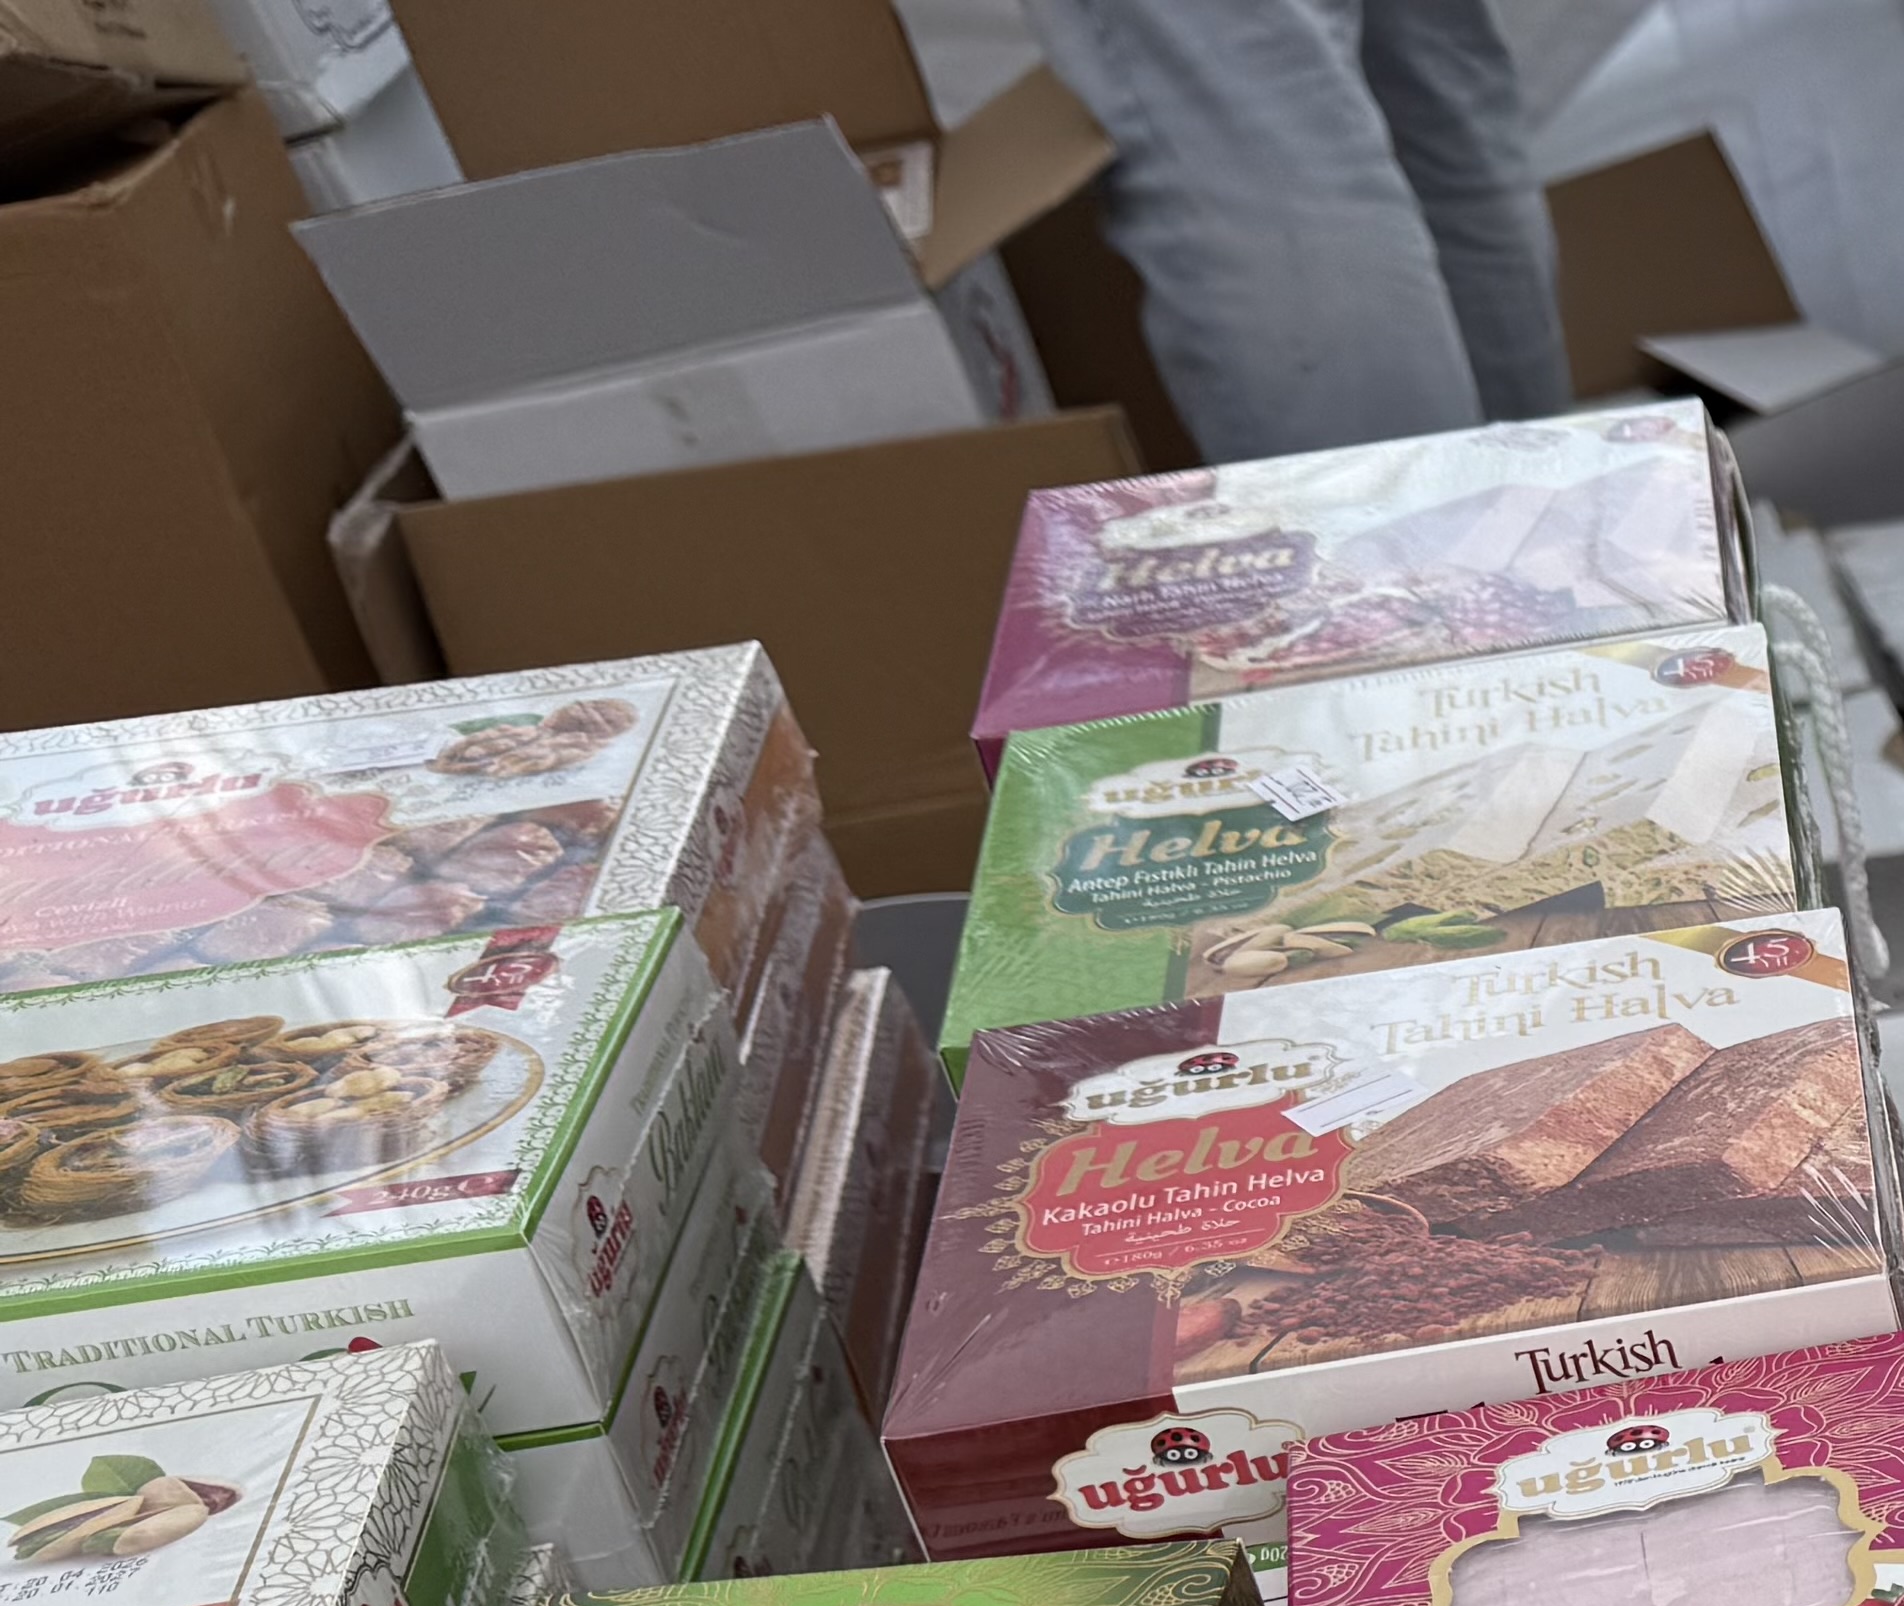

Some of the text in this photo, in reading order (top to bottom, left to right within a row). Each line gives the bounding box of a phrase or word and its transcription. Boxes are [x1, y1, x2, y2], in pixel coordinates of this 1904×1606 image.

[1428, 666, 1603, 723] Turkish
[1347, 696, 1670, 761] Tahini Halva
[1069, 873, 1130, 896] Antep
[1202, 857, 1257, 878] Tahin
[1261, 850, 1319, 870] Helva
[1082, 819, 1309, 871] Helva
[1091, 867, 1292, 905] Tahini Halva Pistachio
[1451, 953, 1663, 1003] Turkish
[1370, 984, 1741, 1056] Tahini Halva
[1086, 1059, 1313, 1109] uğurlu
[1057, 1124, 1321, 1195] Helva
[1042, 1165, 1326, 1226] Kakaolu Tahin Helva
[1082, 1194, 1281, 1239] Tahini Halva Cocoa
[3, 1298, 417, 1375] TRADITIONAL TURKISH
[1514, 1330, 1683, 1395] Turkish
[1077, 1445, 1290, 1513] uğurlu
[1516, 1434, 1753, 1498] uğurlu
